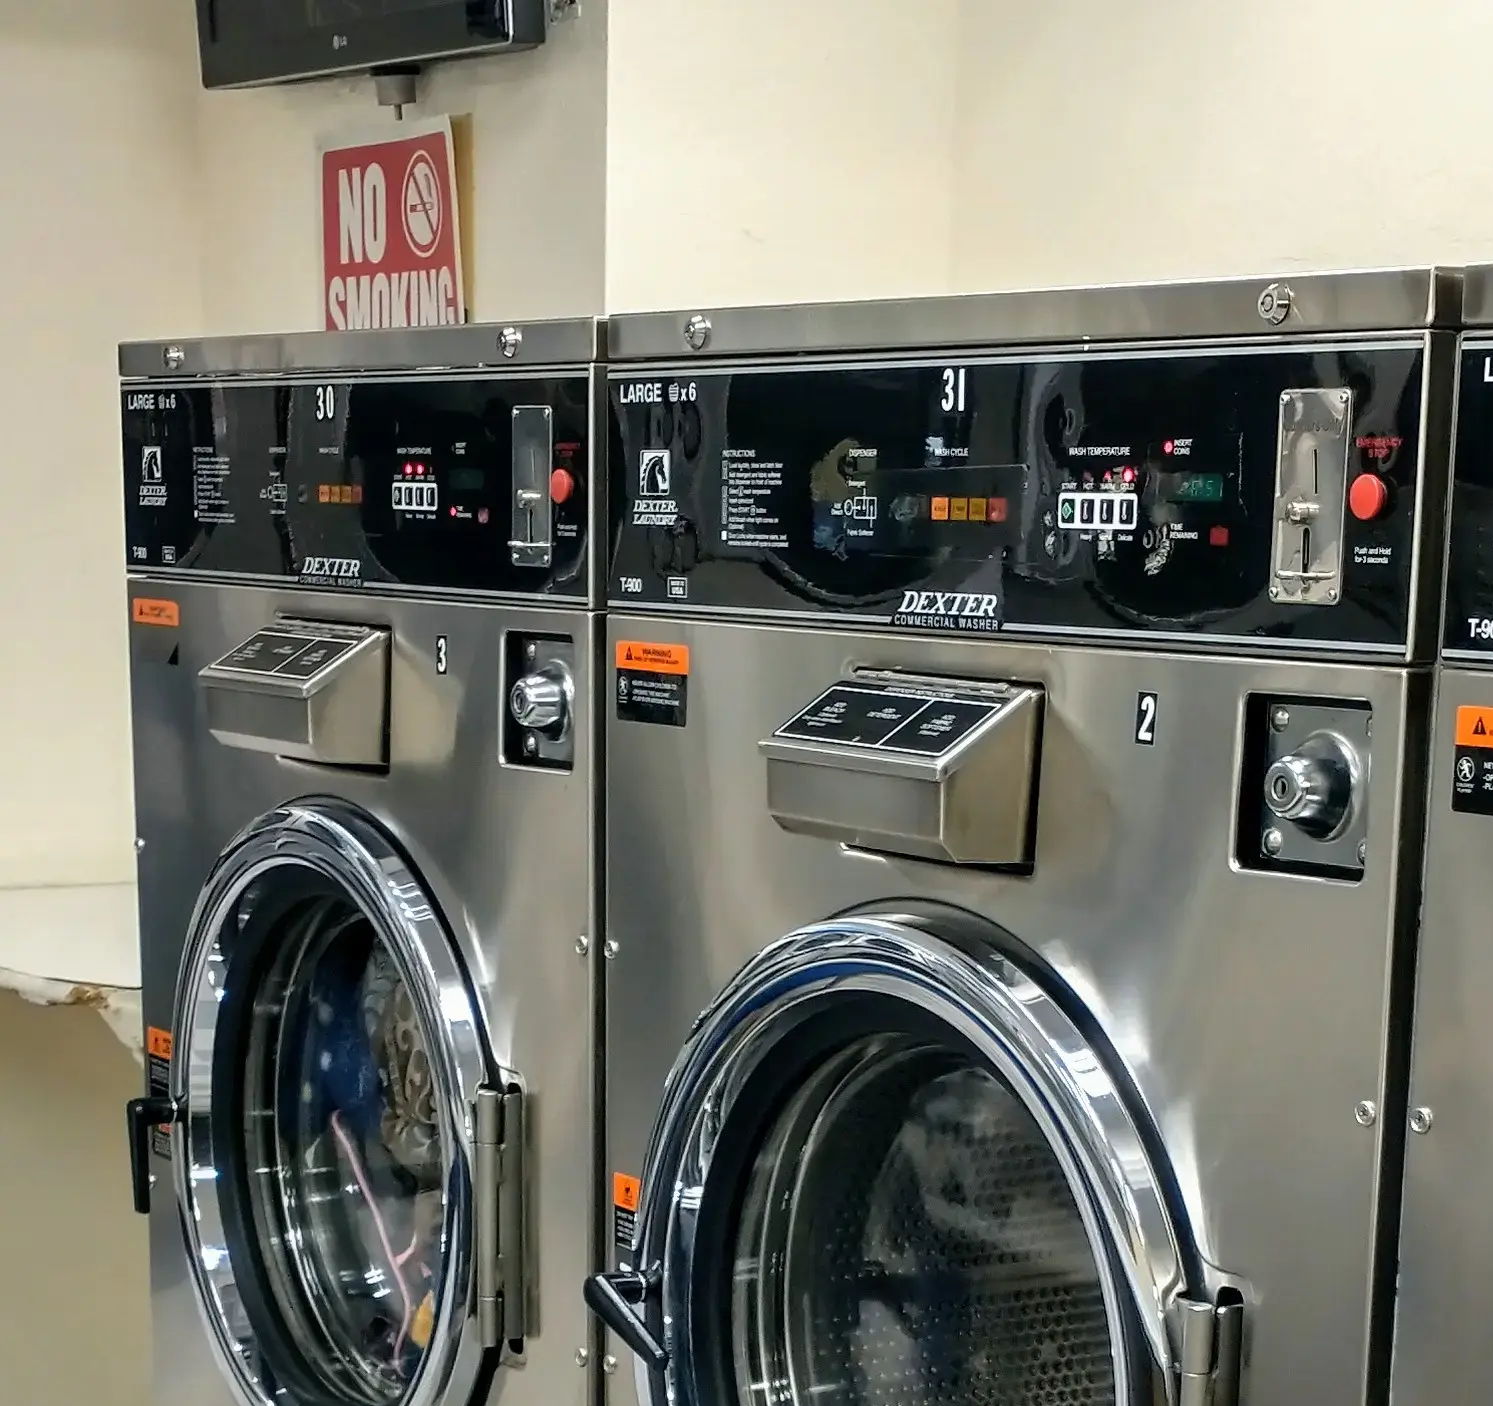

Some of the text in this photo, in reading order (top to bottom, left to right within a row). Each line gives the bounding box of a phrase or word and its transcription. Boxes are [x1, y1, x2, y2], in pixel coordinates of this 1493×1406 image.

[338, 162, 386, 264] NO
[329, 266, 456, 330] SMOKING
[128, 394, 155, 410] LARGE
[316, 386, 334, 420] 30
[620, 383, 662, 403] LARGE
[941, 368, 966, 412] 31
[632, 514, 678, 525] LAUNDRY
[301, 556, 360, 577] DEXTER
[897, 591, 997, 617] DEXTER
[894, 614, 998, 630] COMMERCIAL WASHER
[437, 638, 448, 673] 3
[1138, 695, 1154, 741] 2
